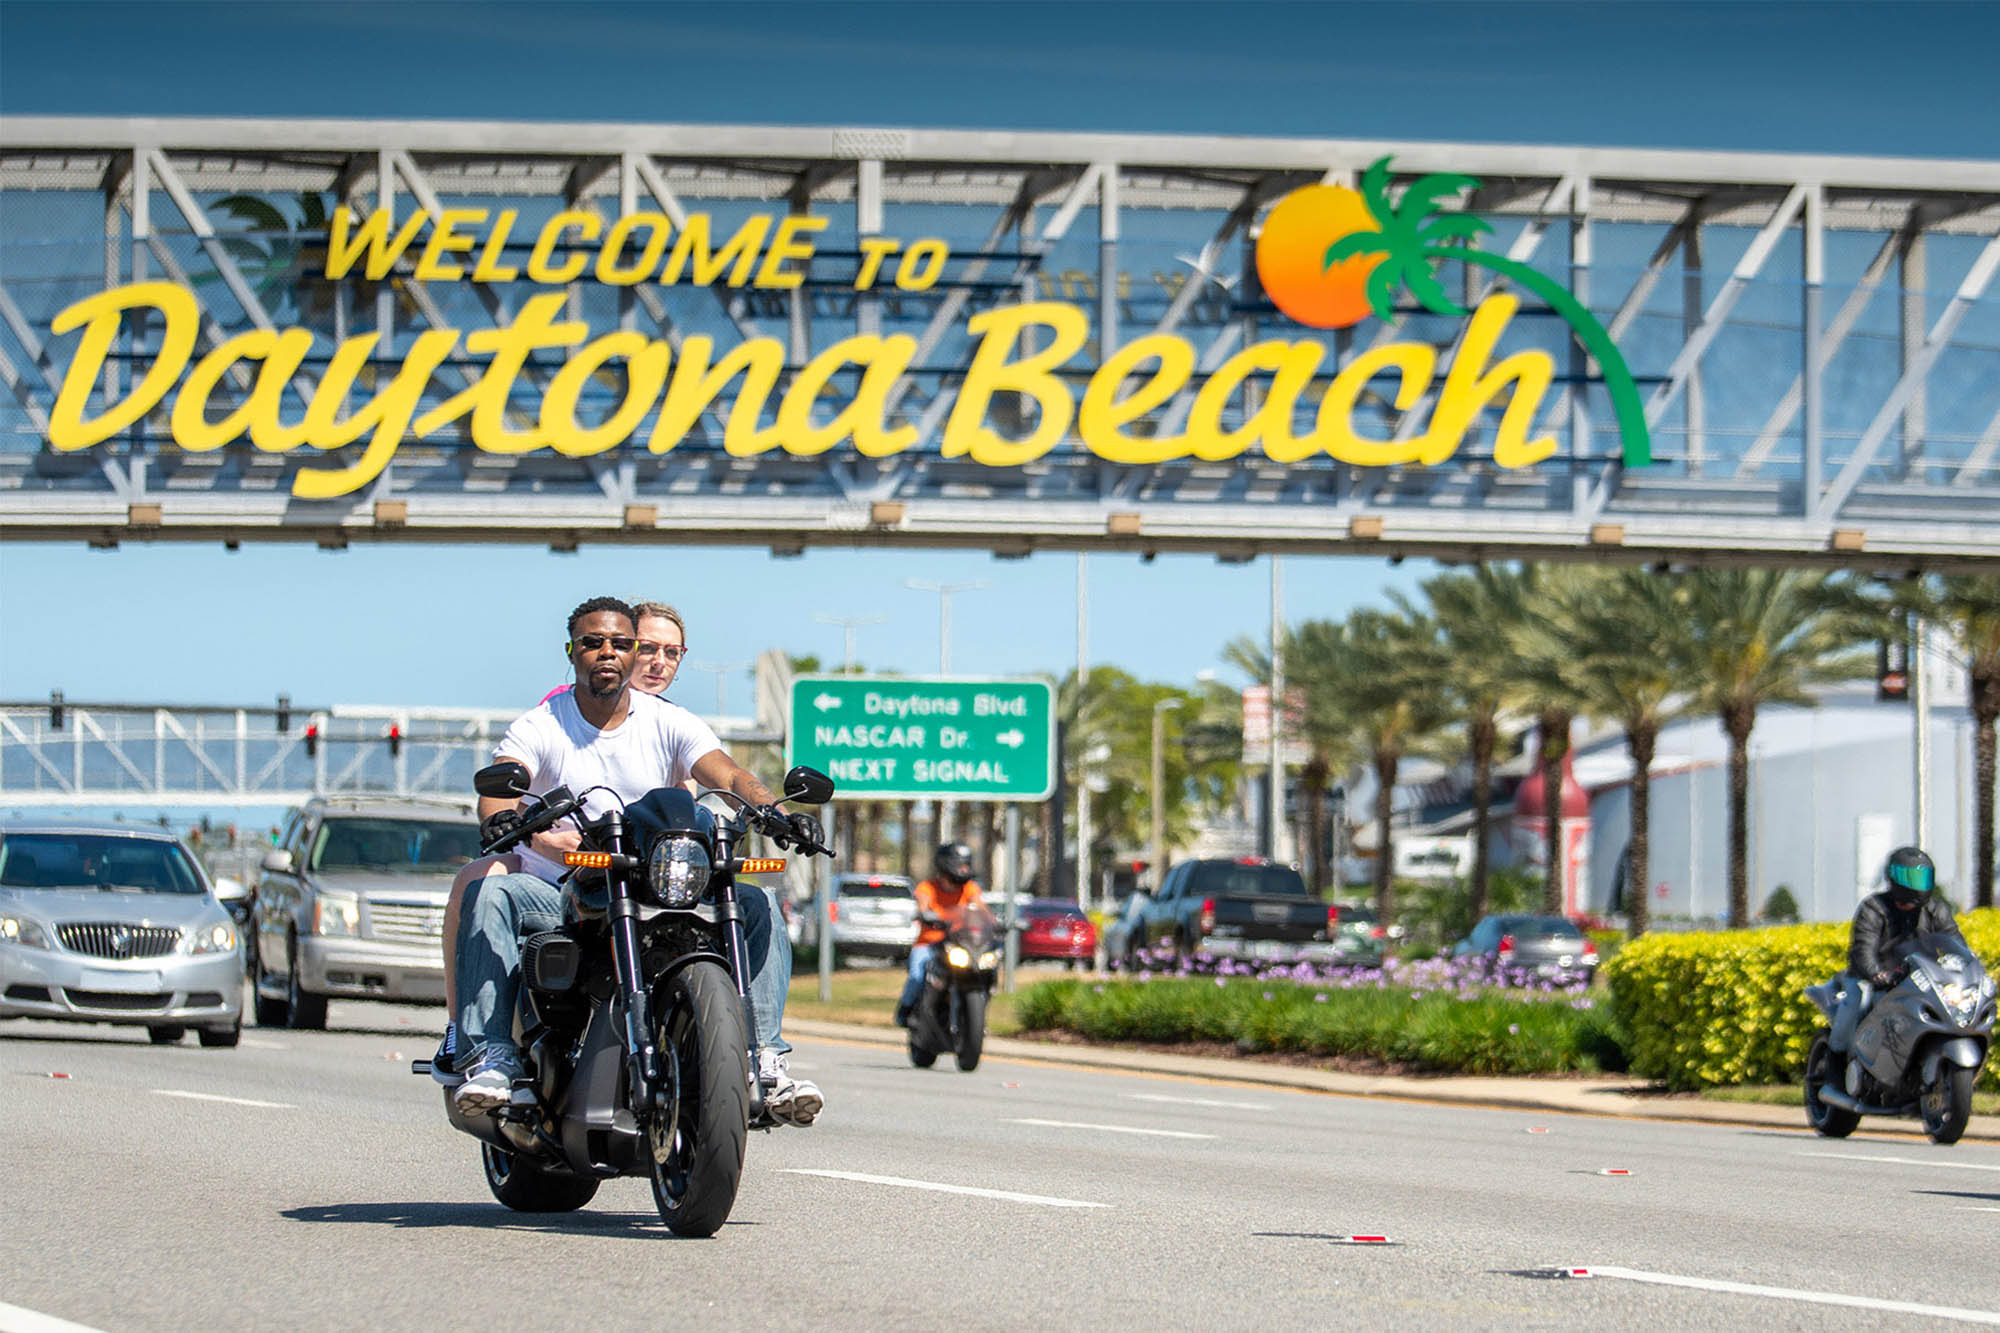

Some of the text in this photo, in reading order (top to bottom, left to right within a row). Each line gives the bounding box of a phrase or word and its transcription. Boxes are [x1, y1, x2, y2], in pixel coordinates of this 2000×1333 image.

[326, 206, 949, 292] WELCOME TO
[48, 281, 1558, 499] Daytona Beach
[865, 692, 961, 719] Daytona
[815, 724, 927, 749] NASCAR
[829, 758, 1010, 784] NEXT SIGNAL
